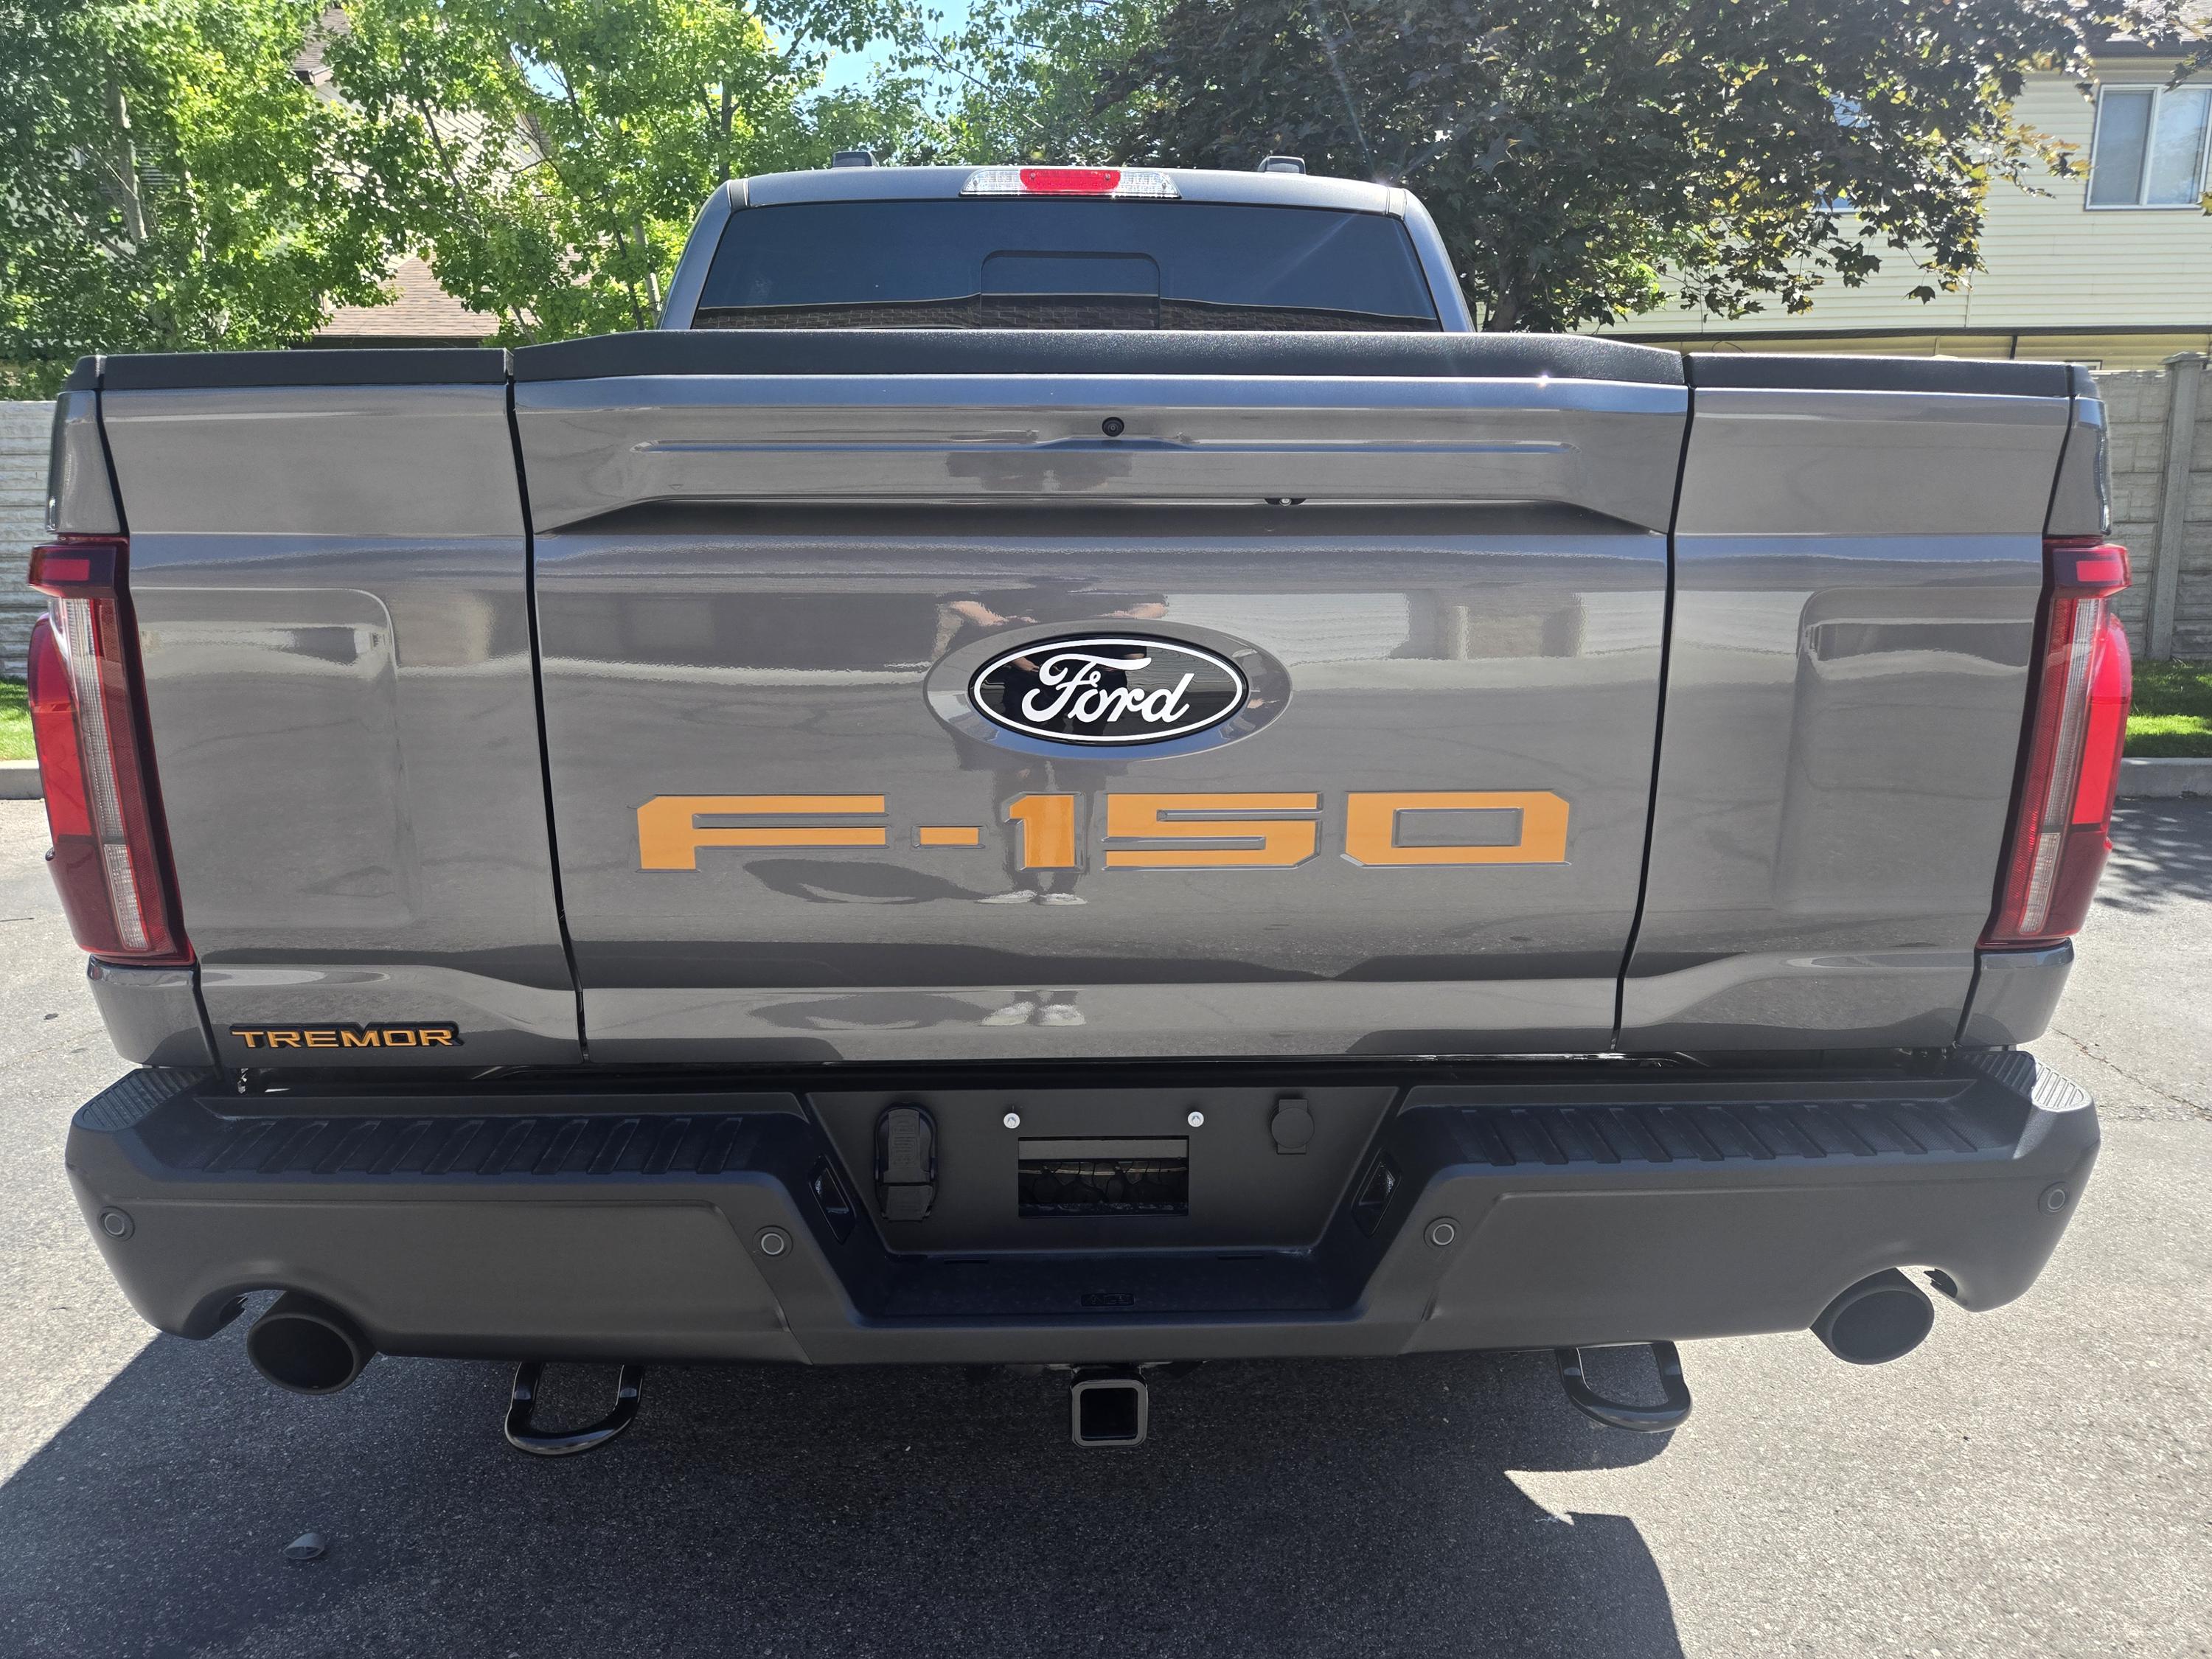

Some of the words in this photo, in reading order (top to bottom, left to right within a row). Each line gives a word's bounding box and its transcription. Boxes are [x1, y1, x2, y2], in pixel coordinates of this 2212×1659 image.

[1021, 653, 1195, 723] Ford
[637, 790, 1569, 871] F-150
[231, 1029, 455, 1048] TREMOR
